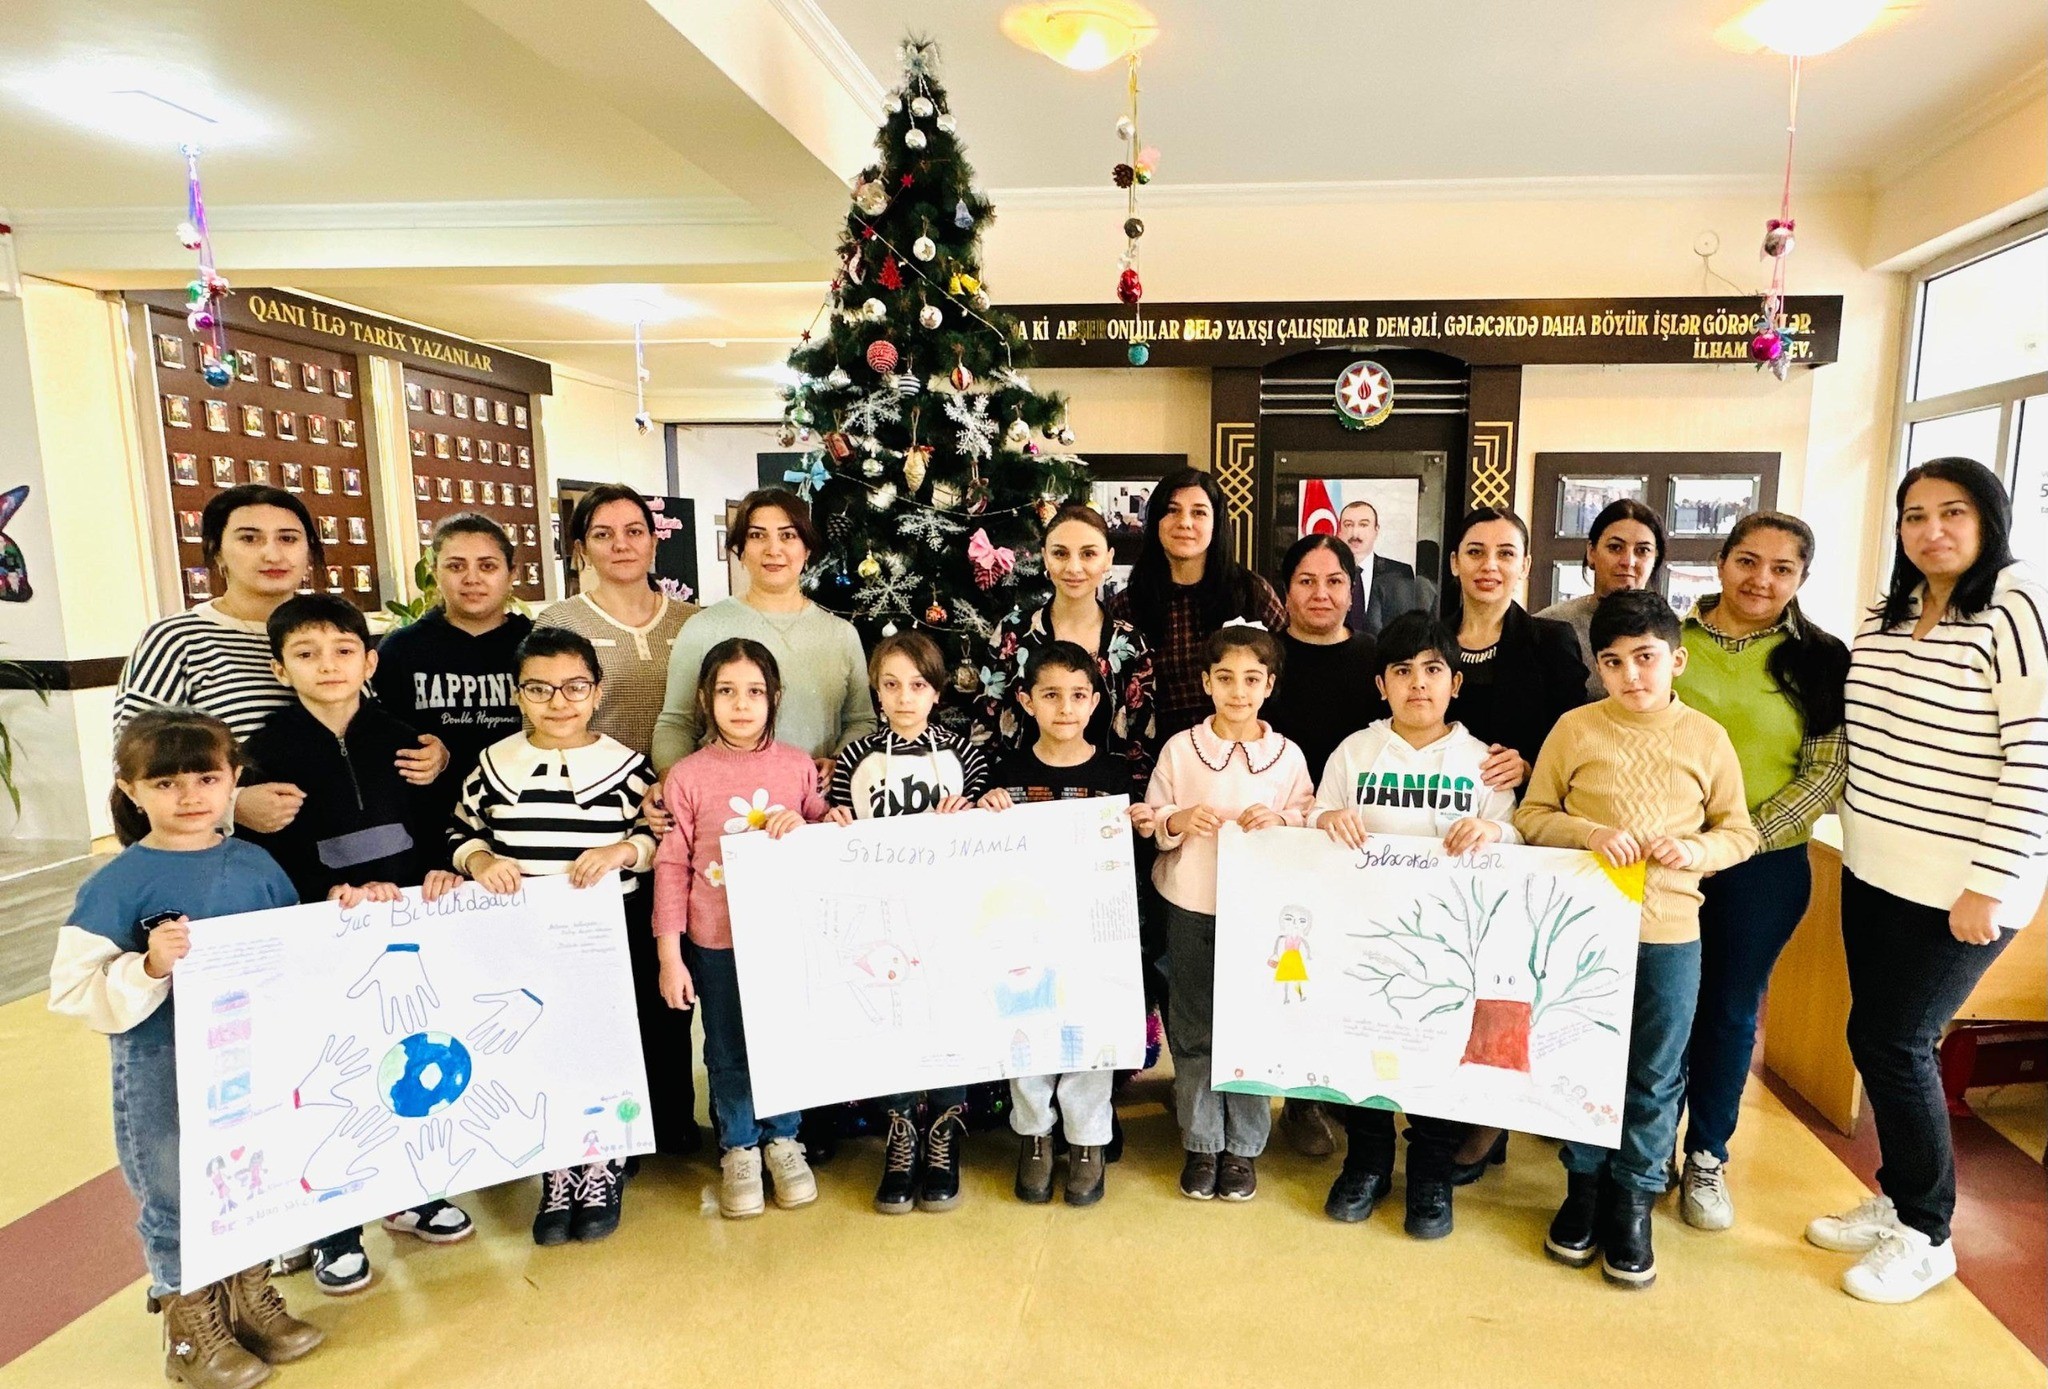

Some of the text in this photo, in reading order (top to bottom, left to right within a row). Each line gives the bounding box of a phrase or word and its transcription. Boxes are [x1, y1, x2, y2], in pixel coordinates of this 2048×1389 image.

[248, 294, 494, 373] QANI İLƏ TARİX YAZANLAR
[1032, 315, 1050, 341] Kİ
[1183, 318, 1224, 341] BELƏ
[1226, 319, 1274, 346] YAXŞI
[1277, 317, 1370, 345] ÇALIŞIRLAR
[1376, 312, 1441, 340] DEMƏLİ,
[1444, 314, 1539, 338] GƏLƏCƏKDƏ
[1541, 314, 1587, 337] DAHA
[1590, 309, 1649, 337] BÖYÜK
[1652, 309, 1701, 341] İŞLƏR
[1693, 337, 1749, 359] İLHAM
[441, 711, 474, 725] Double
